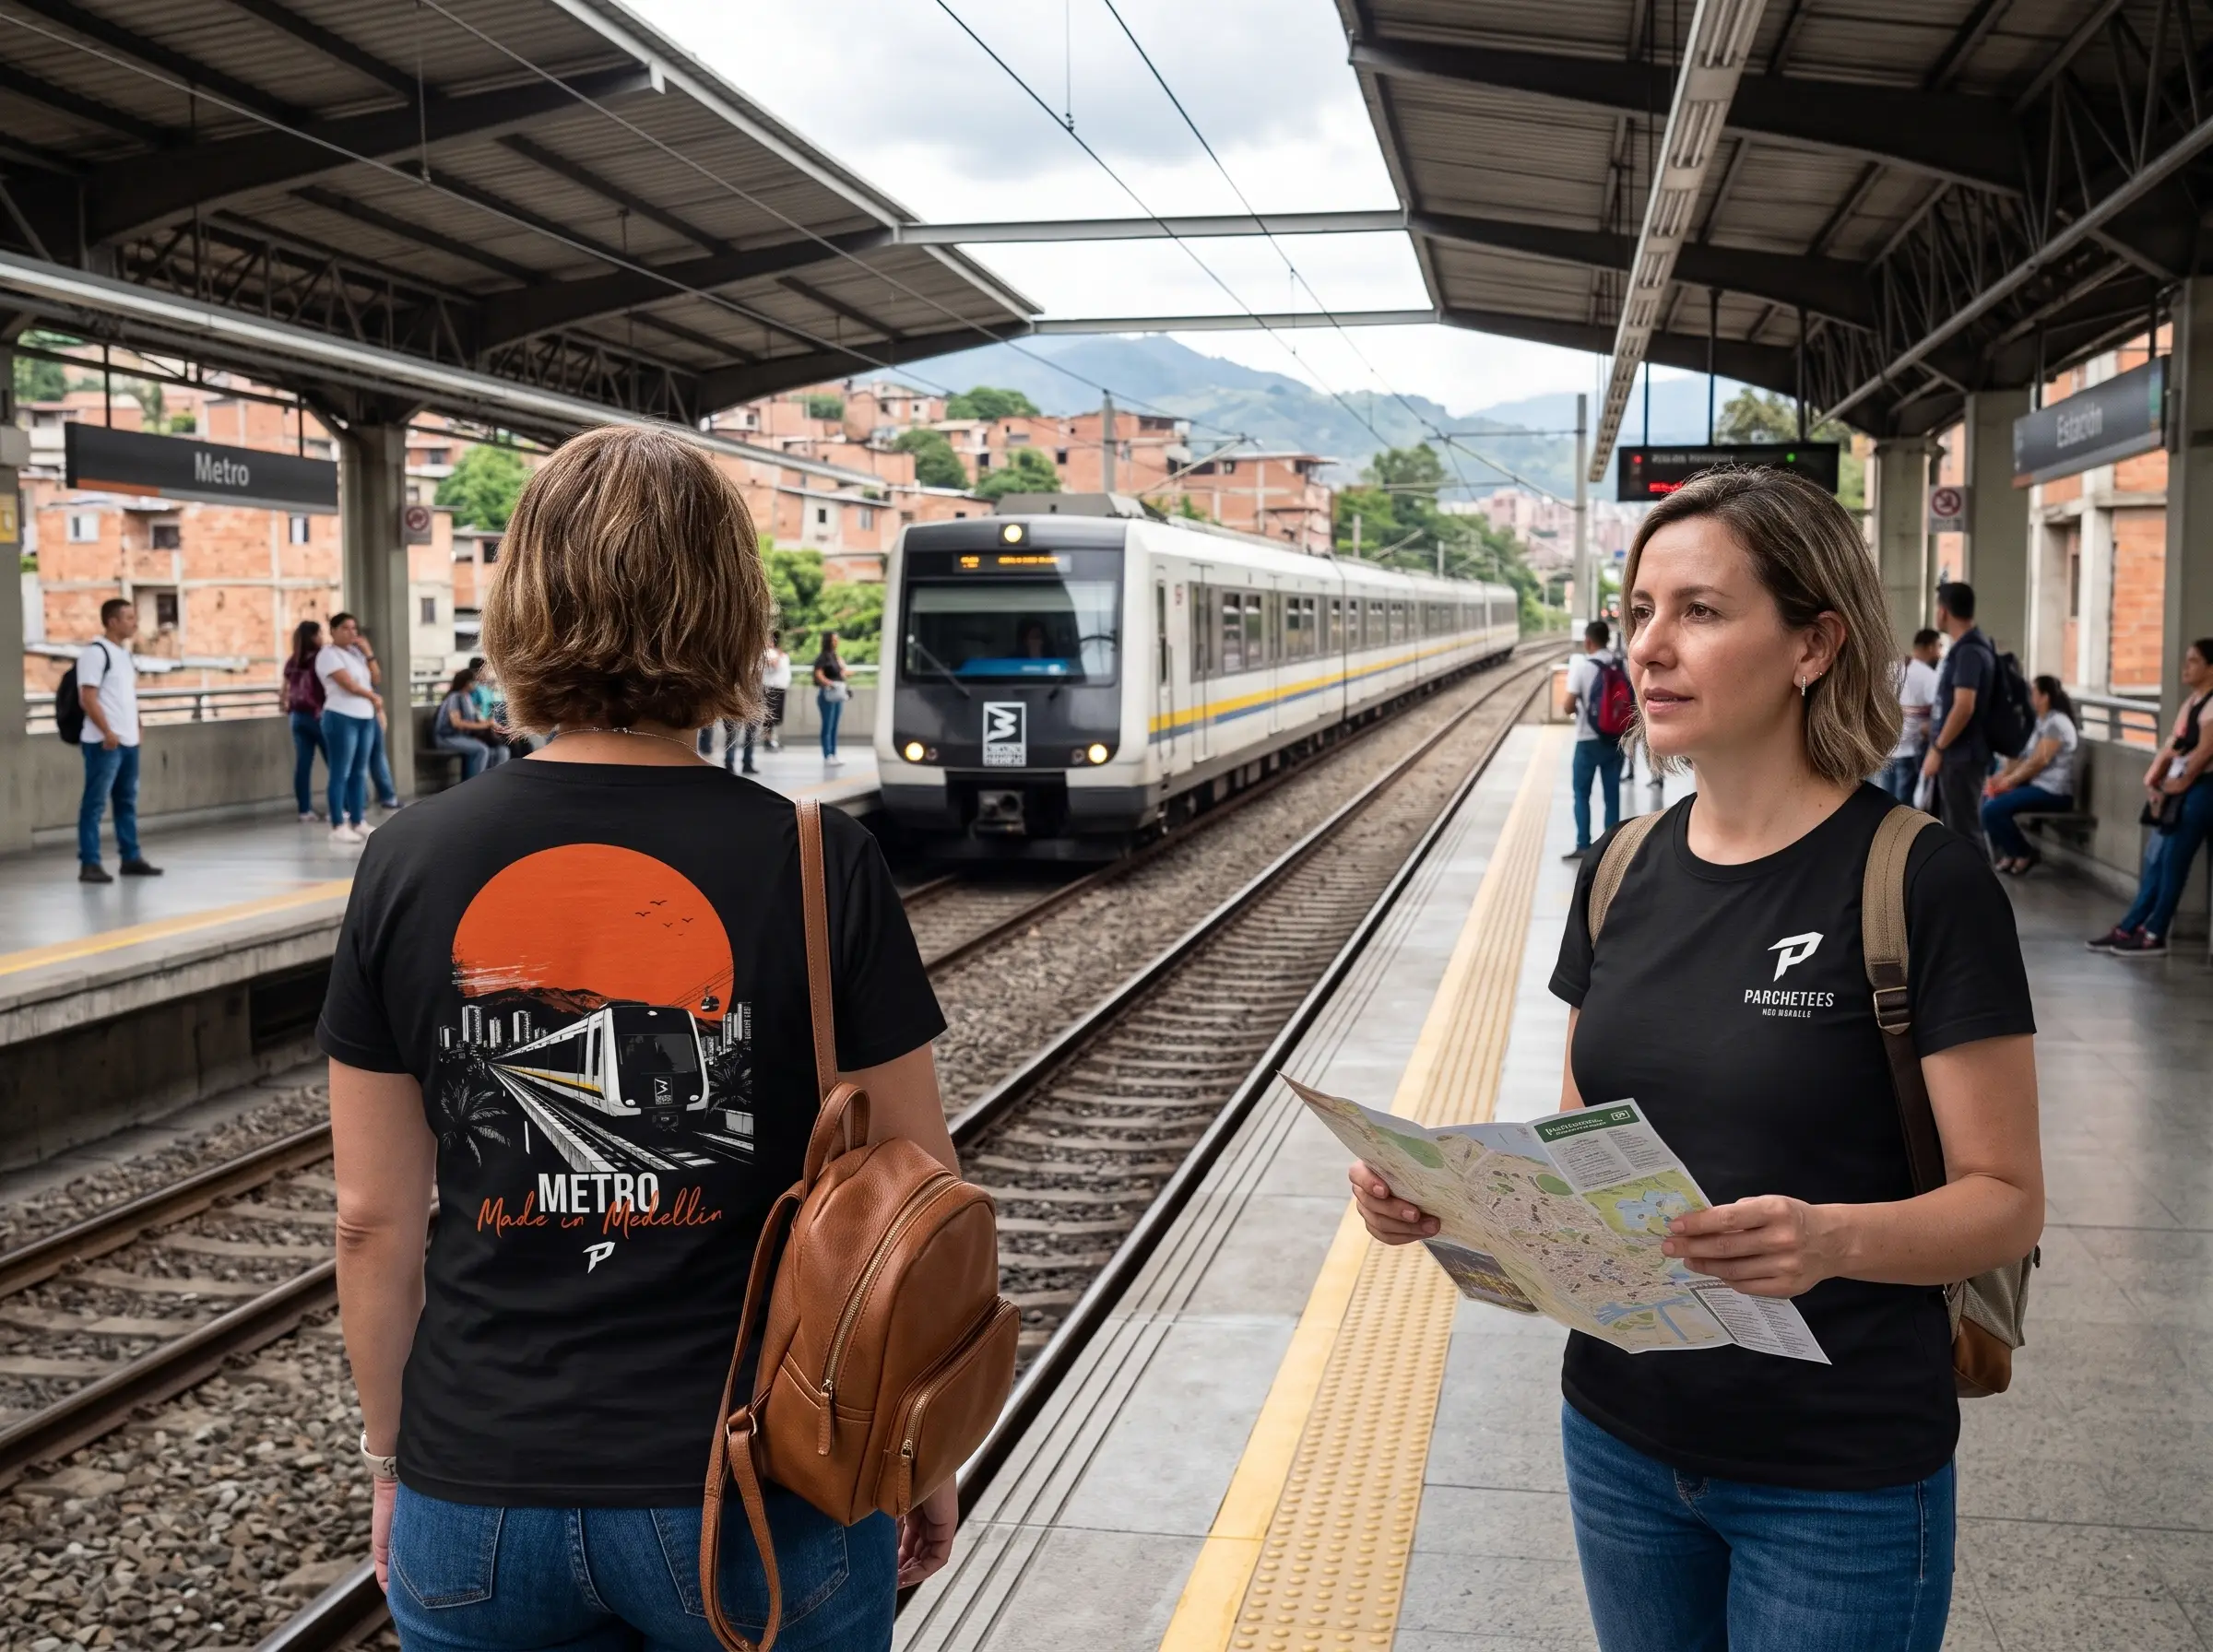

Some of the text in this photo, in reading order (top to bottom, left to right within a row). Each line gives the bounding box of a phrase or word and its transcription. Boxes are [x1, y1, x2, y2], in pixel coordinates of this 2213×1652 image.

[195, 451, 250, 487] Metro
[1744, 989, 1835, 1008] PARCHETEES
[538, 1172, 659, 1213] METRO
[477, 1190, 550, 1238] Made
[561, 1216, 585, 1229] in
